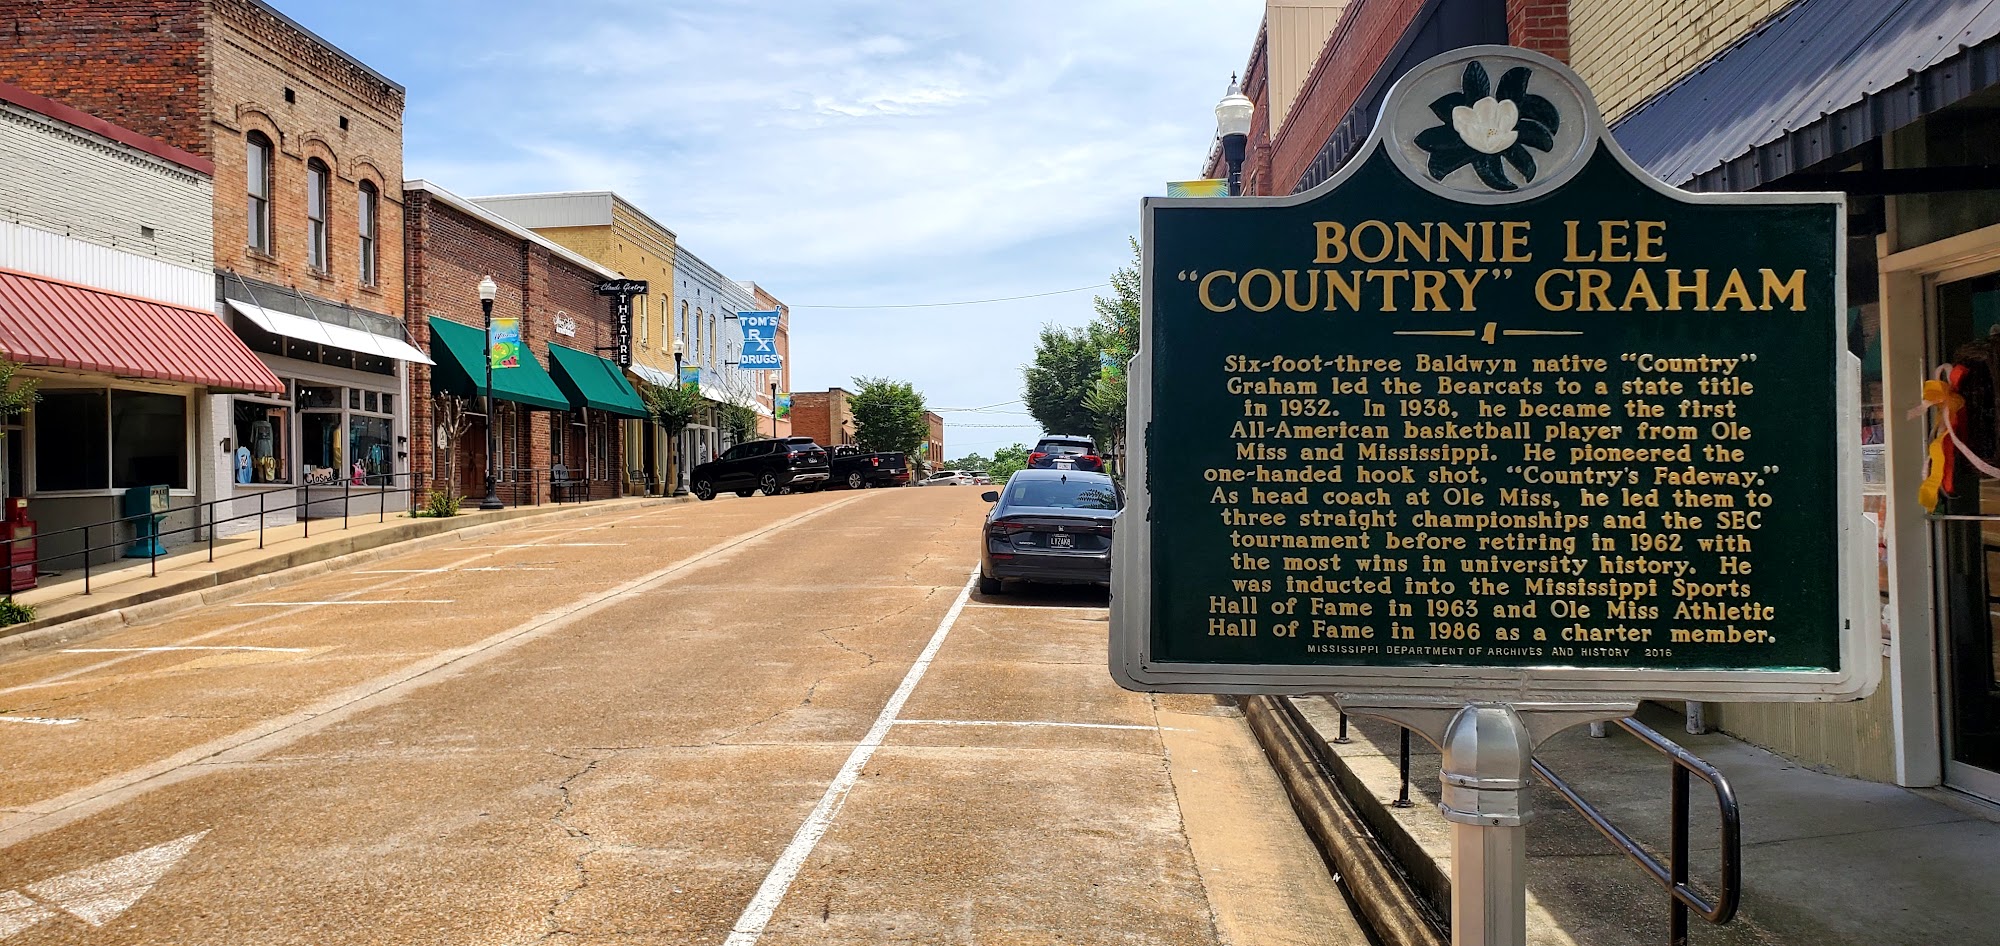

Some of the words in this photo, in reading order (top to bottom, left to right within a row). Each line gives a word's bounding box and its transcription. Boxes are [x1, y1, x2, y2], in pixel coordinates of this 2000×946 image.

[1312, 219, 1533, 264] BONNIE
[1562, 219, 1667, 263] LEE
[1534, 267, 1807, 312] GRAHAM
[619, 294, 629, 364] THEATRE
[740, 316, 777, 327] TOM'S
[741, 354, 777, 364] DRUGS
[1224, 354, 1402, 373] Six-foot-three
[1415, 353, 1517, 375] Baldwyn
[1532, 354, 1608, 373] native
[1227, 376, 1318, 395] Graham
[1331, 376, 1369, 395] led
[1381, 376, 1422, 395] the
[1437, 375, 1543, 395] Bearcats
[1555, 376, 1582, 395] to
[1594, 381, 1609, 395] a
[1621, 376, 1683, 395] state
[1697, 376, 1754, 396] title
[1244, 398, 1268, 417] in
[1280, 398, 1340, 417] 1932.
[1363, 398, 1386, 417] In
[1399, 398, 1459, 419] 1938,
[1478, 399, 1507, 418] he
[1518, 398, 1611, 418] became
[1623, 399, 1665, 418] the
[1678, 399, 1737, 418] first
[1229, 420, 1390, 439] All-American
[1403, 420, 1531, 440] basketball
[1544, 421, 1623, 443] player
[1636, 421, 1698, 440] from
[1711, 421, 1752, 440] Ole
[1236, 442, 1287, 461] Miss
[1300, 442, 1345, 461] and
[1357, 442, 1498, 466] Mississippi.
[1523, 443, 1556, 462] He
[1569, 443, 1692, 465] pioneered
[1702, 443, 1745, 463] the
[1203, 464, 1343, 483] one-handed
[1356, 465, 1416, 484] hook
[1428, 465, 1488, 485] shot,
[1210, 486, 1239, 504] As
[1251, 486, 1309, 505] head
[1322, 487, 1392, 506] coach
[1405, 487, 1430, 506] at
[1443, 487, 1484, 506] Ole
[1499, 487, 1560, 509] Miss,
[1580, 488, 1610, 507] he
[1621, 487, 1660, 508] led
[1671, 489, 1735, 508] them
[1745, 489, 1773, 508] to
[1220, 507, 1286, 526] three
[1299, 509, 1397, 531] straight
[1411, 509, 1589, 533] championships
[1603, 510, 1647, 530] and
[1660, 511, 1703, 530] the
[1716, 510, 1762, 530] SEC
[1229, 529, 1370, 549] tournament
[1385, 531, 1467, 550] before
[1479, 532, 1576, 556] retiring
[1591, 532, 1616, 552] in
[1630, 532, 1683, 552] 1962
[1697, 534, 1752, 553] with
[1230, 552, 1270, 570] the
[1282, 553, 1341, 571] most
[1355, 554, 1408, 572] wins
[1422, 554, 1447, 573] in
[1460, 554, 1588, 577] university
[1599, 555, 1697, 578] history.
[1719, 555, 1752, 575] He
[1231, 579, 1272, 593] was
[1286, 575, 1392, 595] inducted
[1404, 576, 1455, 595] into
[1468, 577, 1510, 596] the
[1524, 577, 1658, 601] Mississippi
[1671, 578, 1751, 601] Sports
[1209, 595, 1258, 614] Hall
[1271, 597, 1298, 615] of
[1310, 597, 1373, 616] Fame
[1388, 598, 1413, 617] in
[1426, 599, 1479, 618] 1963
[1493, 599, 1537, 619] and
[1550, 599, 1591, 619] Ole
[1606, 600, 1659, 620] Miss
[1673, 601, 1775, 621] Athletic
[1207, 618, 1257, 637] Hall
[1272, 620, 1300, 638] of
[1312, 619, 1374, 639] Fame
[1391, 621, 1415, 640] in
[1429, 621, 1481, 641] 1986
[1495, 627, 1520, 641] as
[1533, 627, 1547, 641] a
[1561, 622, 1652, 642] charter
[1669, 624, 1776, 644] member.
[1307, 644, 1379, 654] MISSISSIPPI
[1386, 645, 1464, 656] DEPARTMENT
[1468, 646, 1483, 655] OF
[1487, 646, 1543, 656] ARCHIVES
[1552, 646, 1574, 657] AND
[1581, 647, 1630, 657] HISTORY
[1644, 648, 1672, 657] 2016
